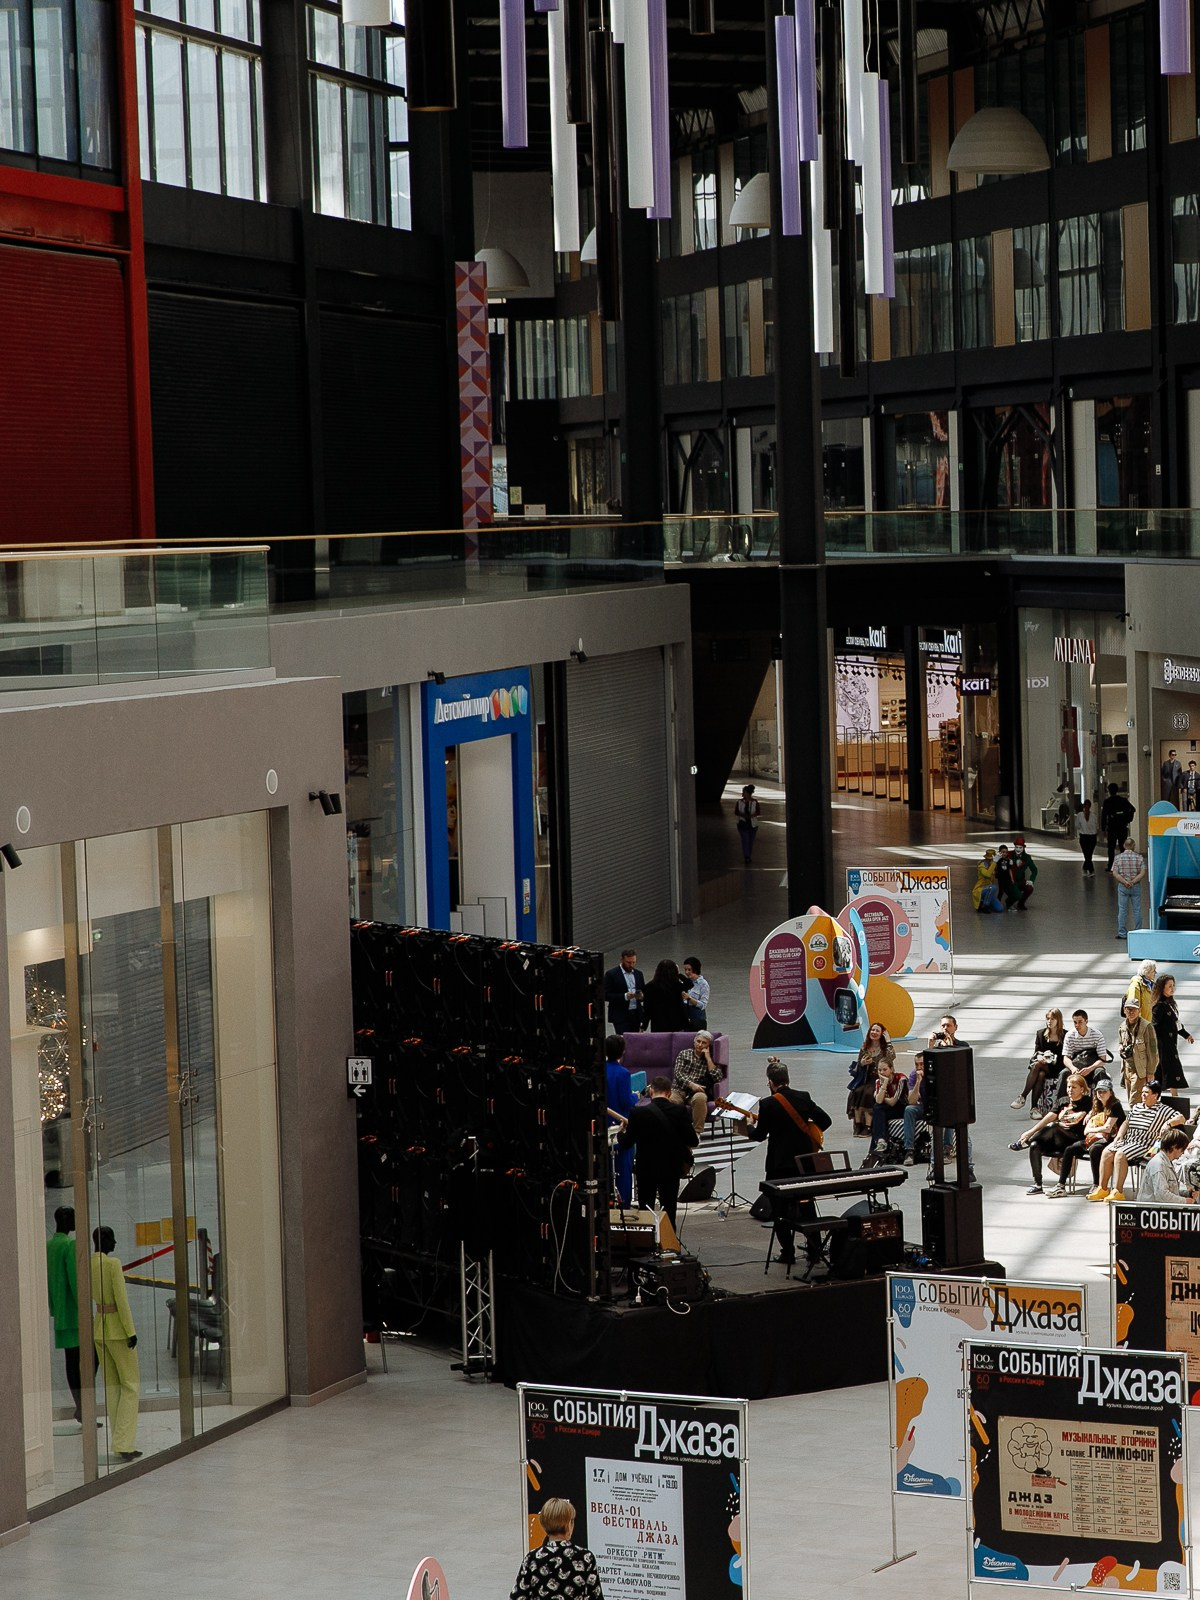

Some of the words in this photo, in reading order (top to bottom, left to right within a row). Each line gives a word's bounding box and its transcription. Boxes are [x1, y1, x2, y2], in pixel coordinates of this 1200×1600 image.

[868, 626, 886, 648] kari
[944, 630, 962, 653] kari
[1054, 637, 1092, 664] MILANA
[962, 678, 990, 691] kari
[434, 693, 472, 723] Детский
[473, 697, 490, 722] мир
[1183, 822, 1200, 831] ИГРАЙ
[862, 872, 900, 883] СОБЫТИЯ
[900, 872, 948, 893] Джаза
[918, 1282, 990, 1307] СОБЫТИЯ
[991, 1287, 1082, 1333] Джаза
[923, 1305, 938, 1313] России
[943, 1307, 960, 1315] Самаре
[999, 1350, 1079, 1378] СОБЫТИЯ
[1078, 1354, 1181, 1406] Джаза
[553, 1399, 636, 1429] СОБЫТИЯ
[634, 1404, 740, 1460] Джаза
[1061, 1431, 1118, 1446] МУЗЫКАЛЬНЫЕ
[1121, 1435, 1157, 1449] ВТОРНИКИ
[1066, 1449, 1086, 1458] САЛОНЕ
[593, 1469, 605, 1478] 17
[615, 1472, 627, 1482] ДОМ
[665, 1480, 678, 1490] 19.00
[1008, 1491, 1053, 1504] ДЖАЗ
[590, 1501, 641, 1517] ВЕСНА-01
[602, 1515, 668, 1532] ФЕСТИВАЛЬ
[636, 1531, 679, 1546] ДЖАЗА
[606, 1547, 638, 1558] ОРКЕСТР
[598, 1566, 621, 1575] ВАРТЕТ
